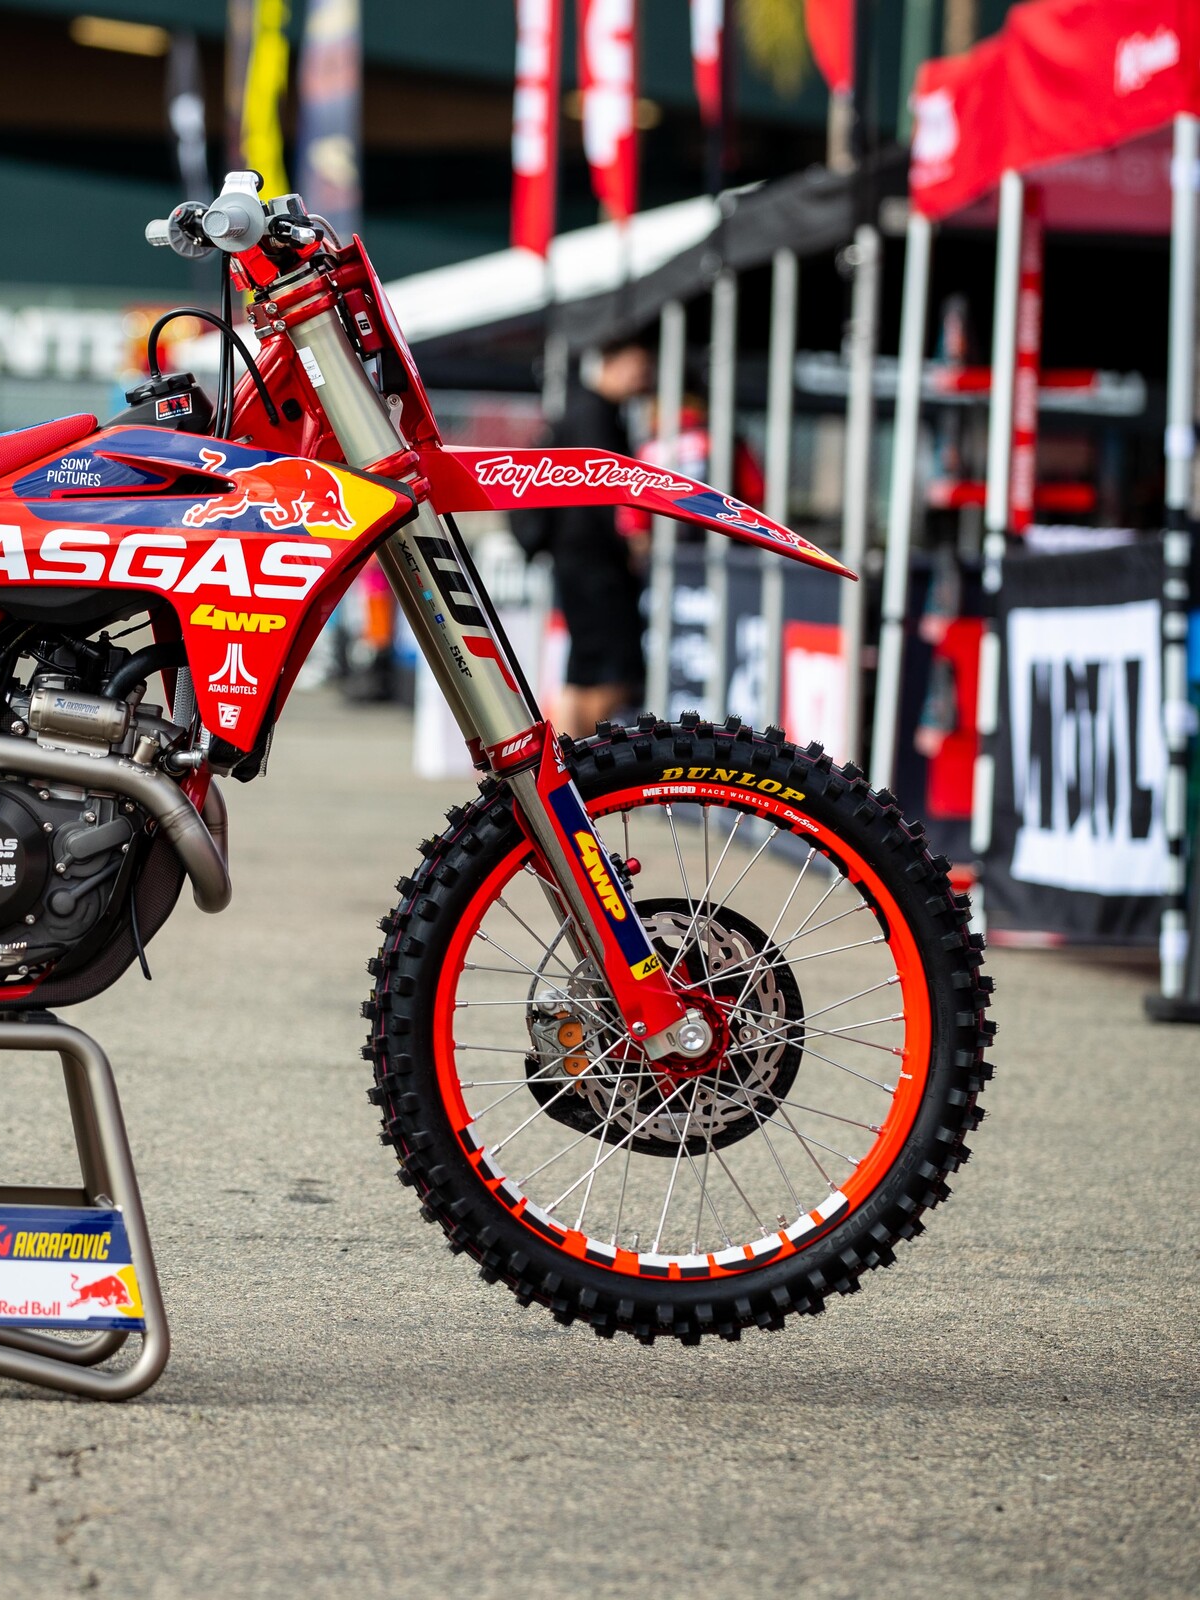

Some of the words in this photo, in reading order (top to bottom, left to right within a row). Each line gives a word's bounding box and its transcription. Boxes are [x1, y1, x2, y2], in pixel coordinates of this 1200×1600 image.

[46, 469, 102, 488] PICTURES
[60, 458, 91, 472] SONY
[475, 456, 535, 498] Troy
[532, 457, 584, 487] Lee
[585, 458, 694, 497] Designs
[398, 539, 421, 573] XACT
[190, 604, 287, 633] 4WP
[449, 645, 473, 679] SKF
[208, 683, 229, 694] ATARI
[230, 684, 257, 695] HOTELS
[501, 733, 534, 758] WP
[642, 785, 697, 797] METHOD
[700, 787, 726, 796] RACE
[730, 791, 770, 808] WHEELS
[659, 767, 806, 802] DUNLOP
[574, 830, 626, 921] 4WP
[31, 1301, 61, 1316] Bull
